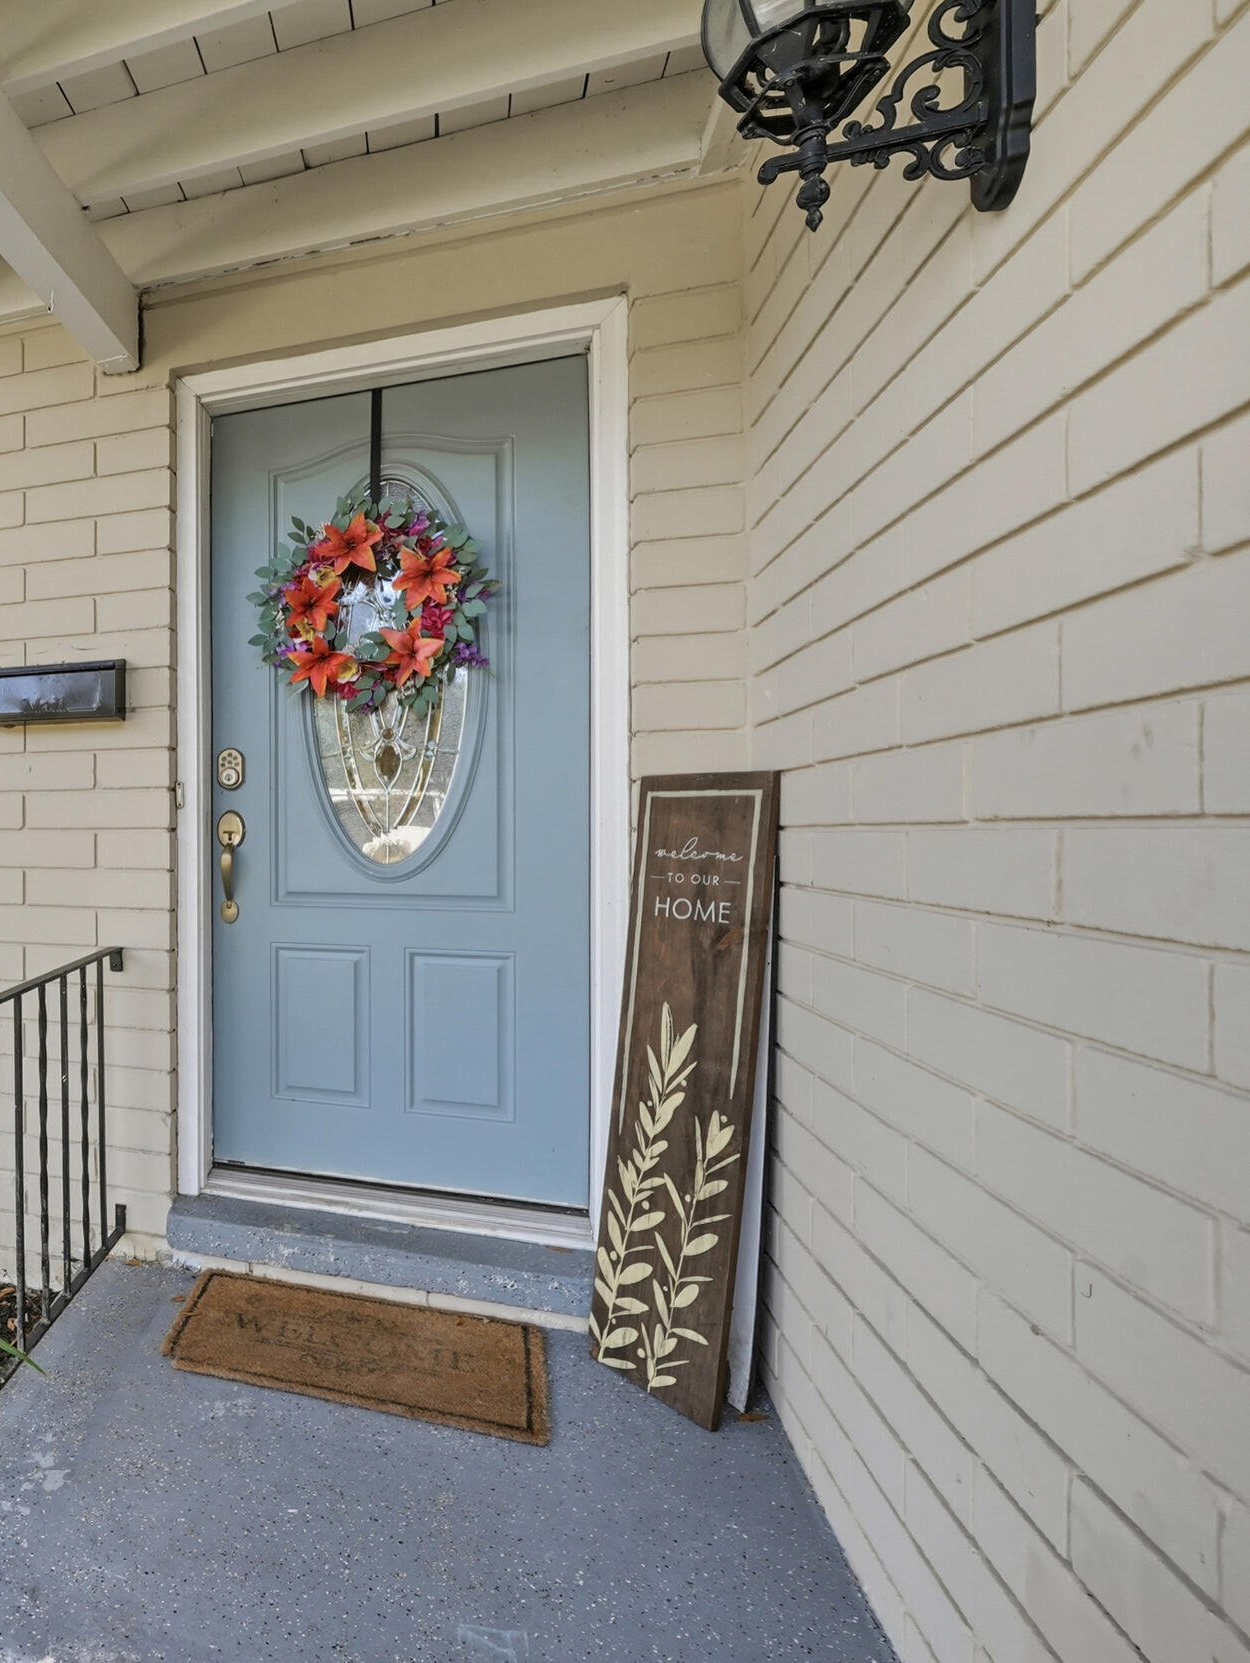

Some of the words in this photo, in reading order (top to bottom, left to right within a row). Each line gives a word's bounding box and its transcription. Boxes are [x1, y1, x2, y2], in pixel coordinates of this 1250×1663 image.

[655, 837, 743, 862] welcome
[667, 872, 685, 884] TO
[690, 873, 720, 886] OUR
[654, 896, 732, 924] HOME
